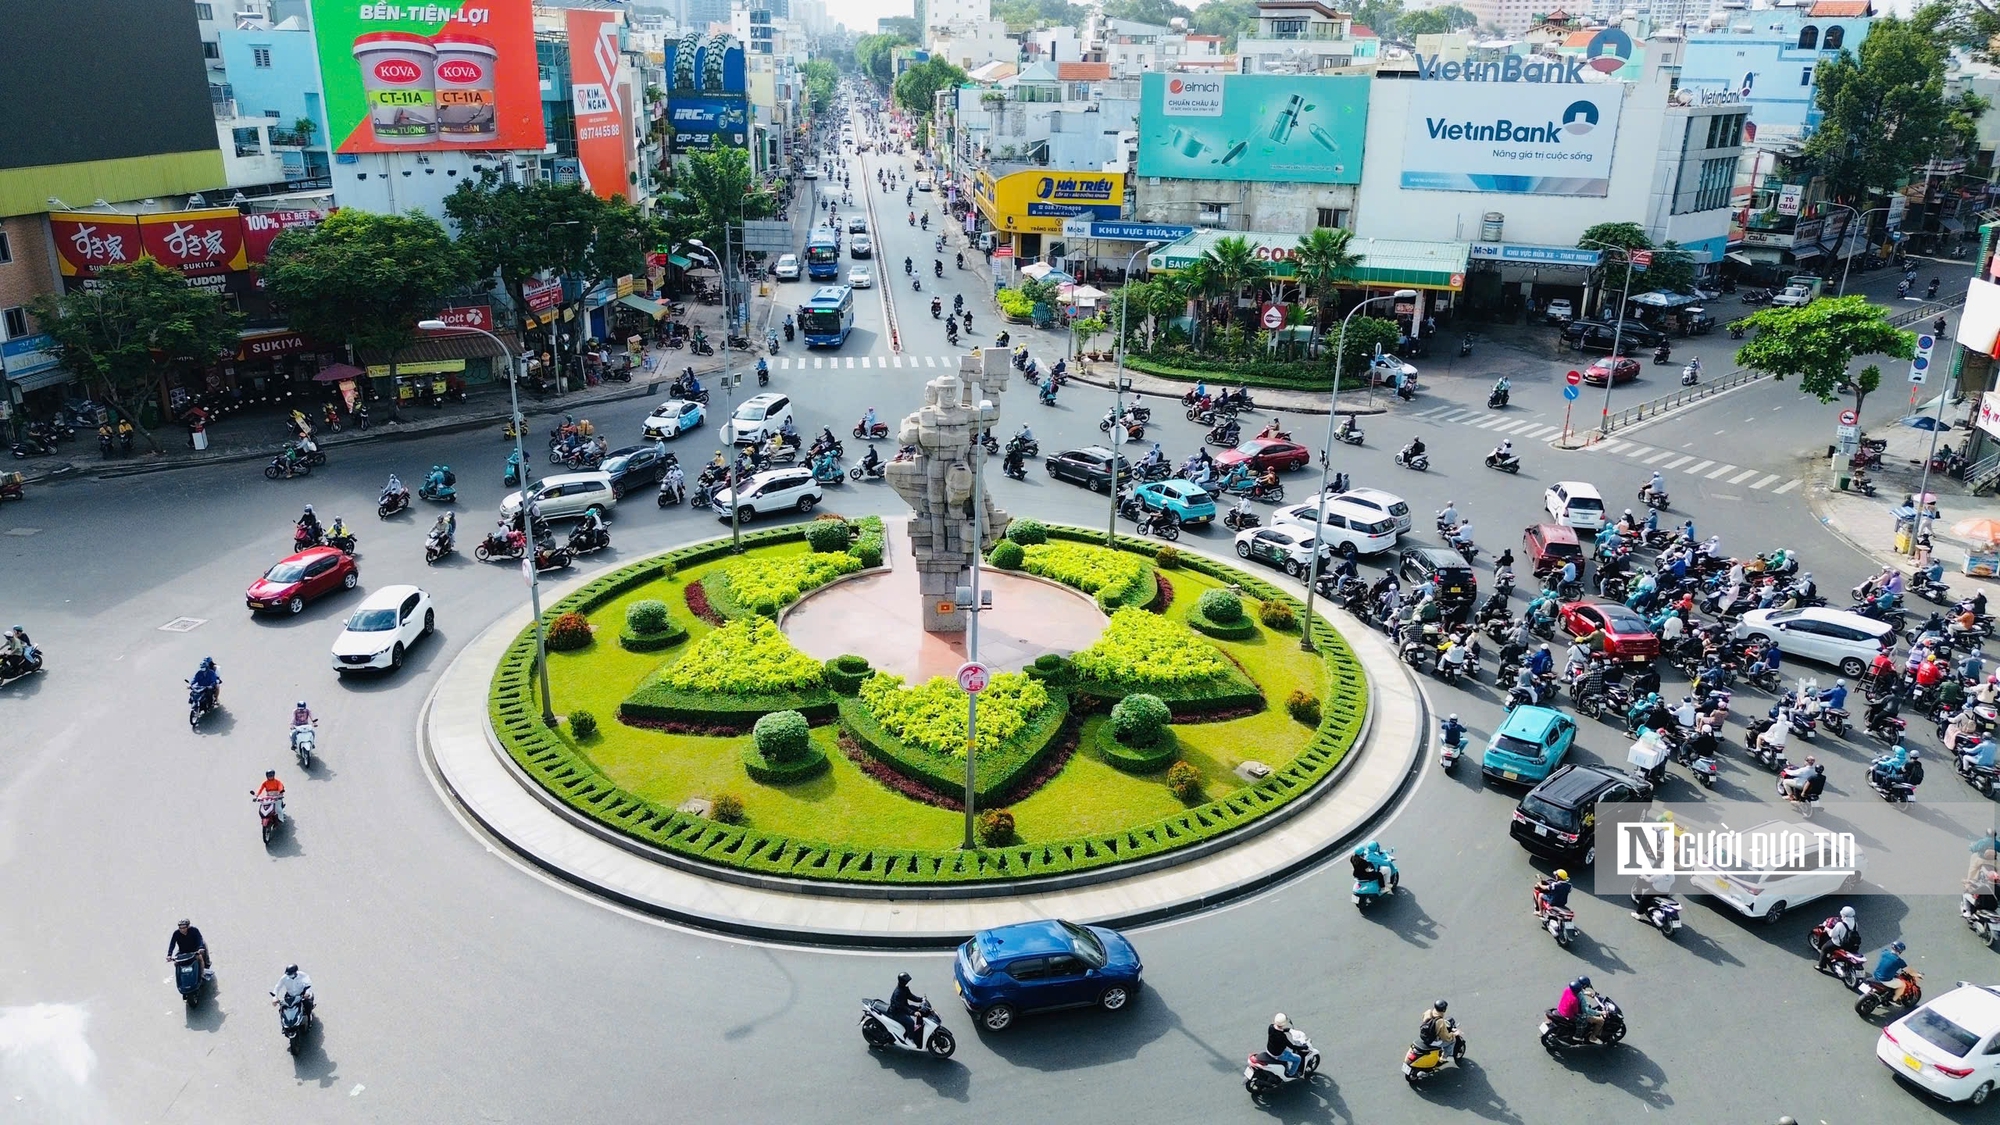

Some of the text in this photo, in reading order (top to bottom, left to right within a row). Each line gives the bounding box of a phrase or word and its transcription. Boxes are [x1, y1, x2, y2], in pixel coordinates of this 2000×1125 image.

[360, 0, 489, 26] BỀN-TIỆN-LỢI
[381, 66, 416, 77] KOVA
[443, 66, 477, 78] KOVA
[1415, 53, 1586, 83] VietinBank
[1185, 81, 1219, 92] elmich
[380, 92, 423, 103] CT-11A
[442, 92, 483, 103] CT-11A
[1701, 87, 1741, 104] VietinBank
[1426, 117, 1562, 143] VietinBank
[676, 133, 709, 143] GP-22
[1492, 149, 1517, 159] Nâng
[1519, 150, 1533, 159] giá
[1546, 151, 1568, 162] cuộc
[1570, 151, 1593, 162] sống
[294, 211, 310, 220] BEEF
[245, 215, 279, 231] 100%
[1123, 228, 1144, 236] VỰC
[70, 222, 126, 264] すき家
[163, 222, 226, 260] すき家
[1473, 246, 1498, 255] Mobil
[183, 261, 216, 271] SUKIYA
[185, 274, 226, 287] YUDON
[252, 337, 303, 354] SUKIYA
